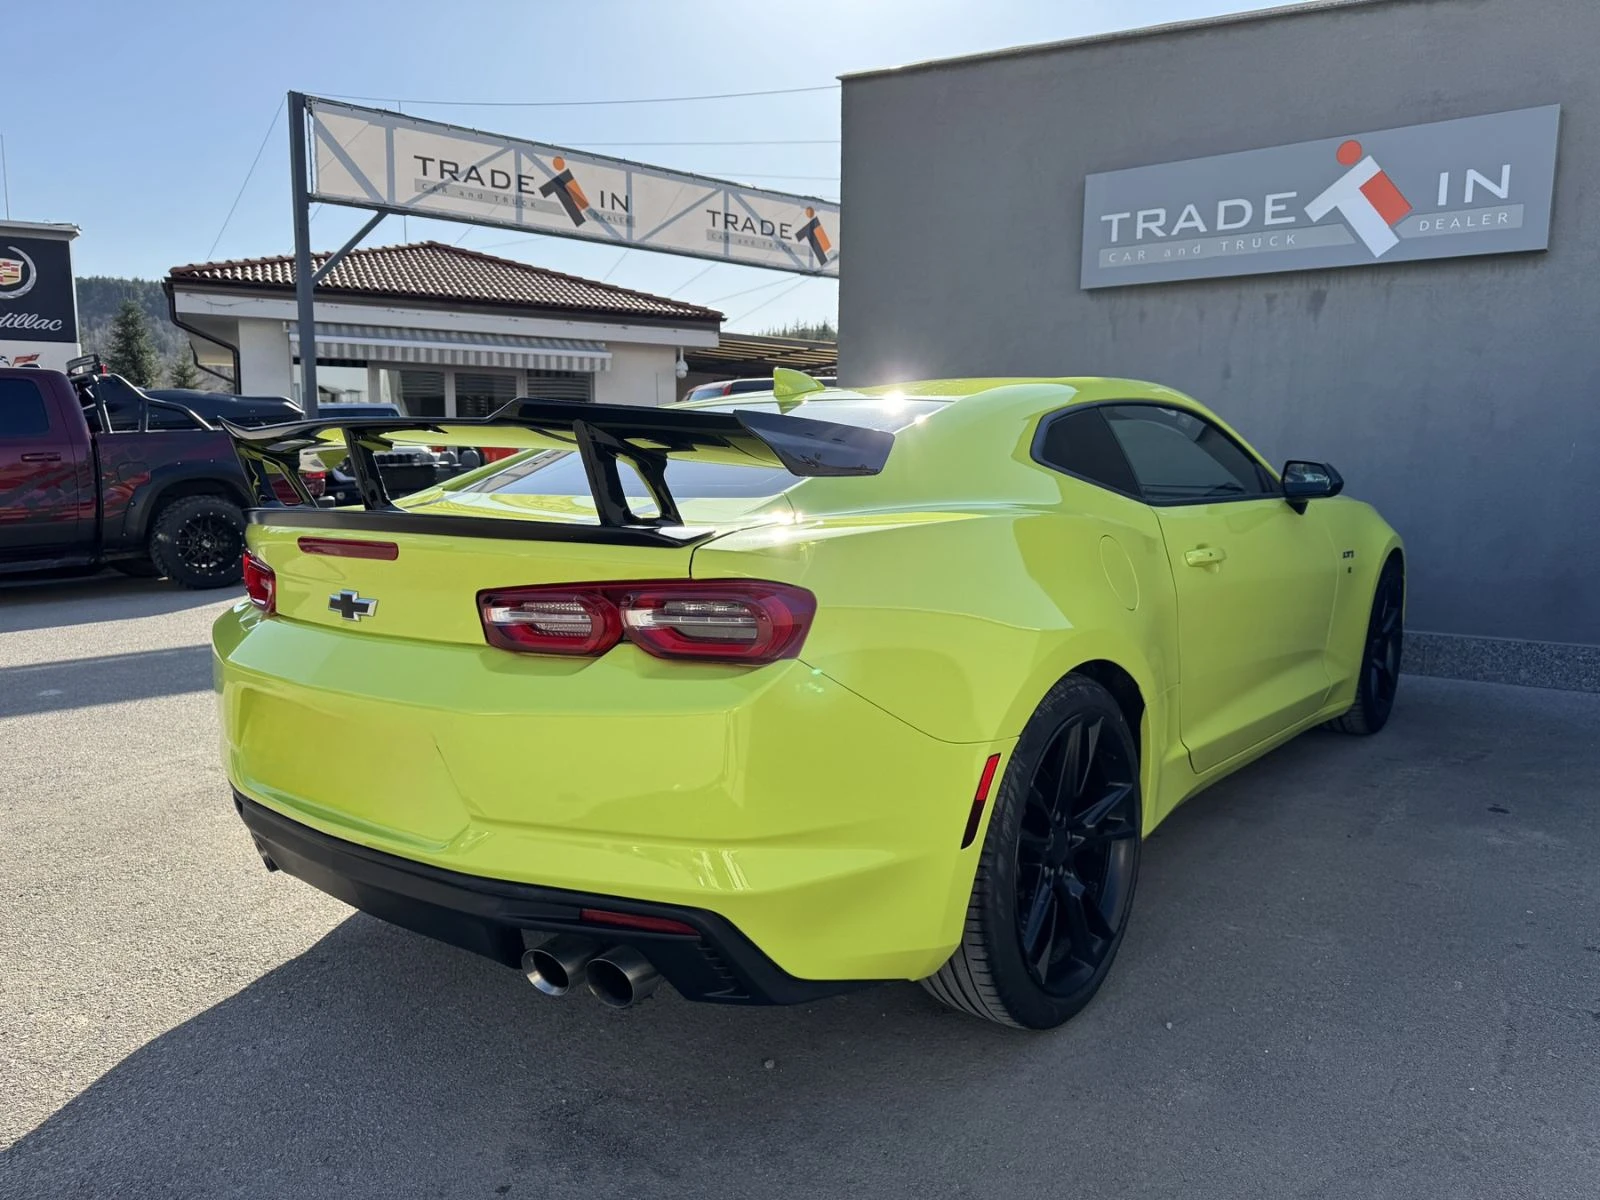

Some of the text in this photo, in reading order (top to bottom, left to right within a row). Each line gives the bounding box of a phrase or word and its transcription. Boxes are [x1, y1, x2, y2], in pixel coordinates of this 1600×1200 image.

[413, 155, 629, 213] TRADE IN
[459, 191, 484, 200] and
[1100, 164, 1511, 243] TRADE IN
[706, 209, 793, 240] TRADE
[1419, 212, 1509, 232] DEALER
[1108, 234, 1296, 263] CAR and TRUCK
